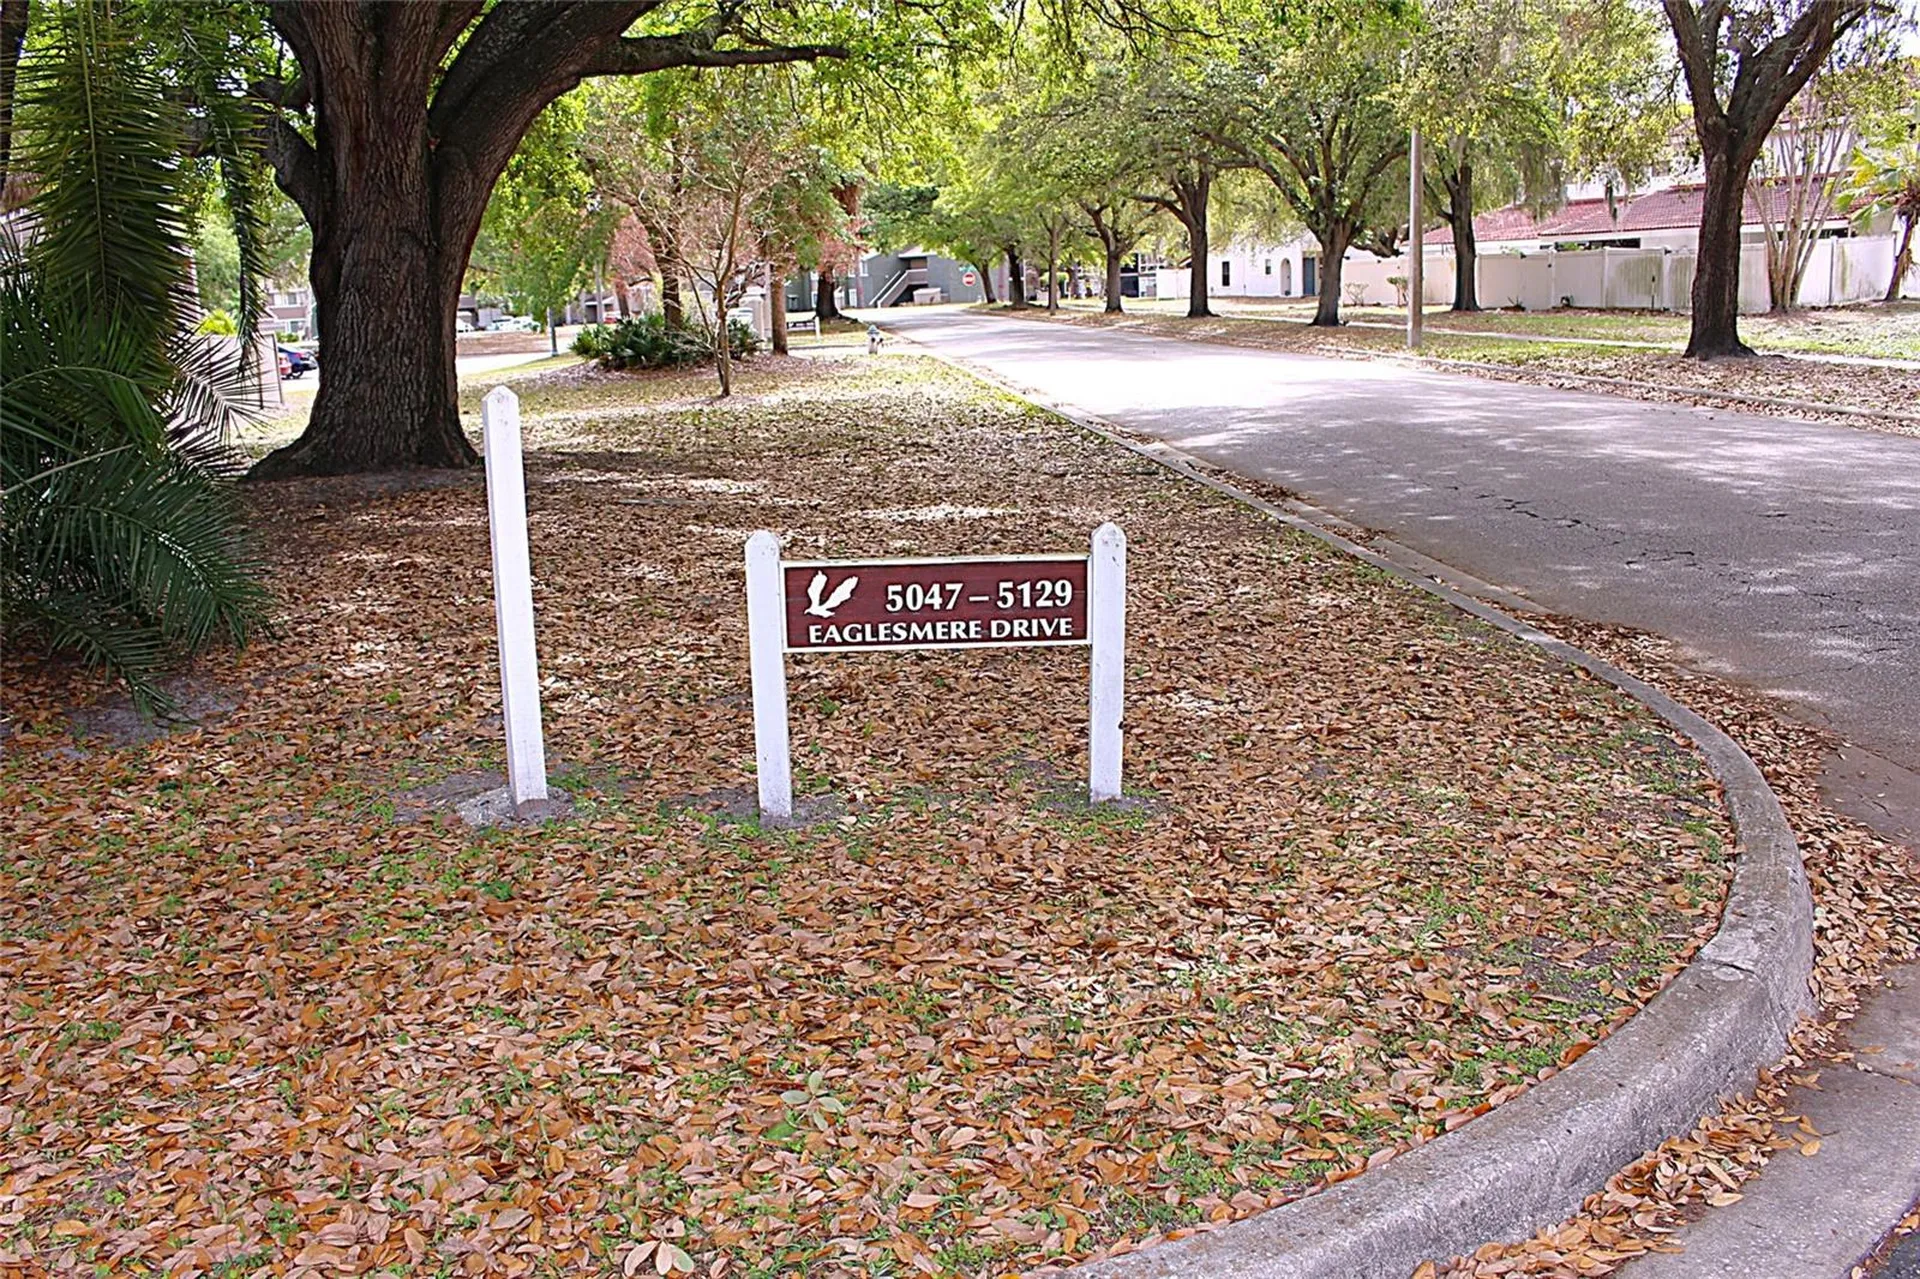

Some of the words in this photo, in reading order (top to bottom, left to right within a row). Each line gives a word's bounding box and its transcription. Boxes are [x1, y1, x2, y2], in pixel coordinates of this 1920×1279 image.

[885, 583, 963, 612] 5047
[996, 579, 1073, 609] 5129
[808, 619, 982, 643] EAGLESMERE
[990, 617, 1073, 638] DRIVE
